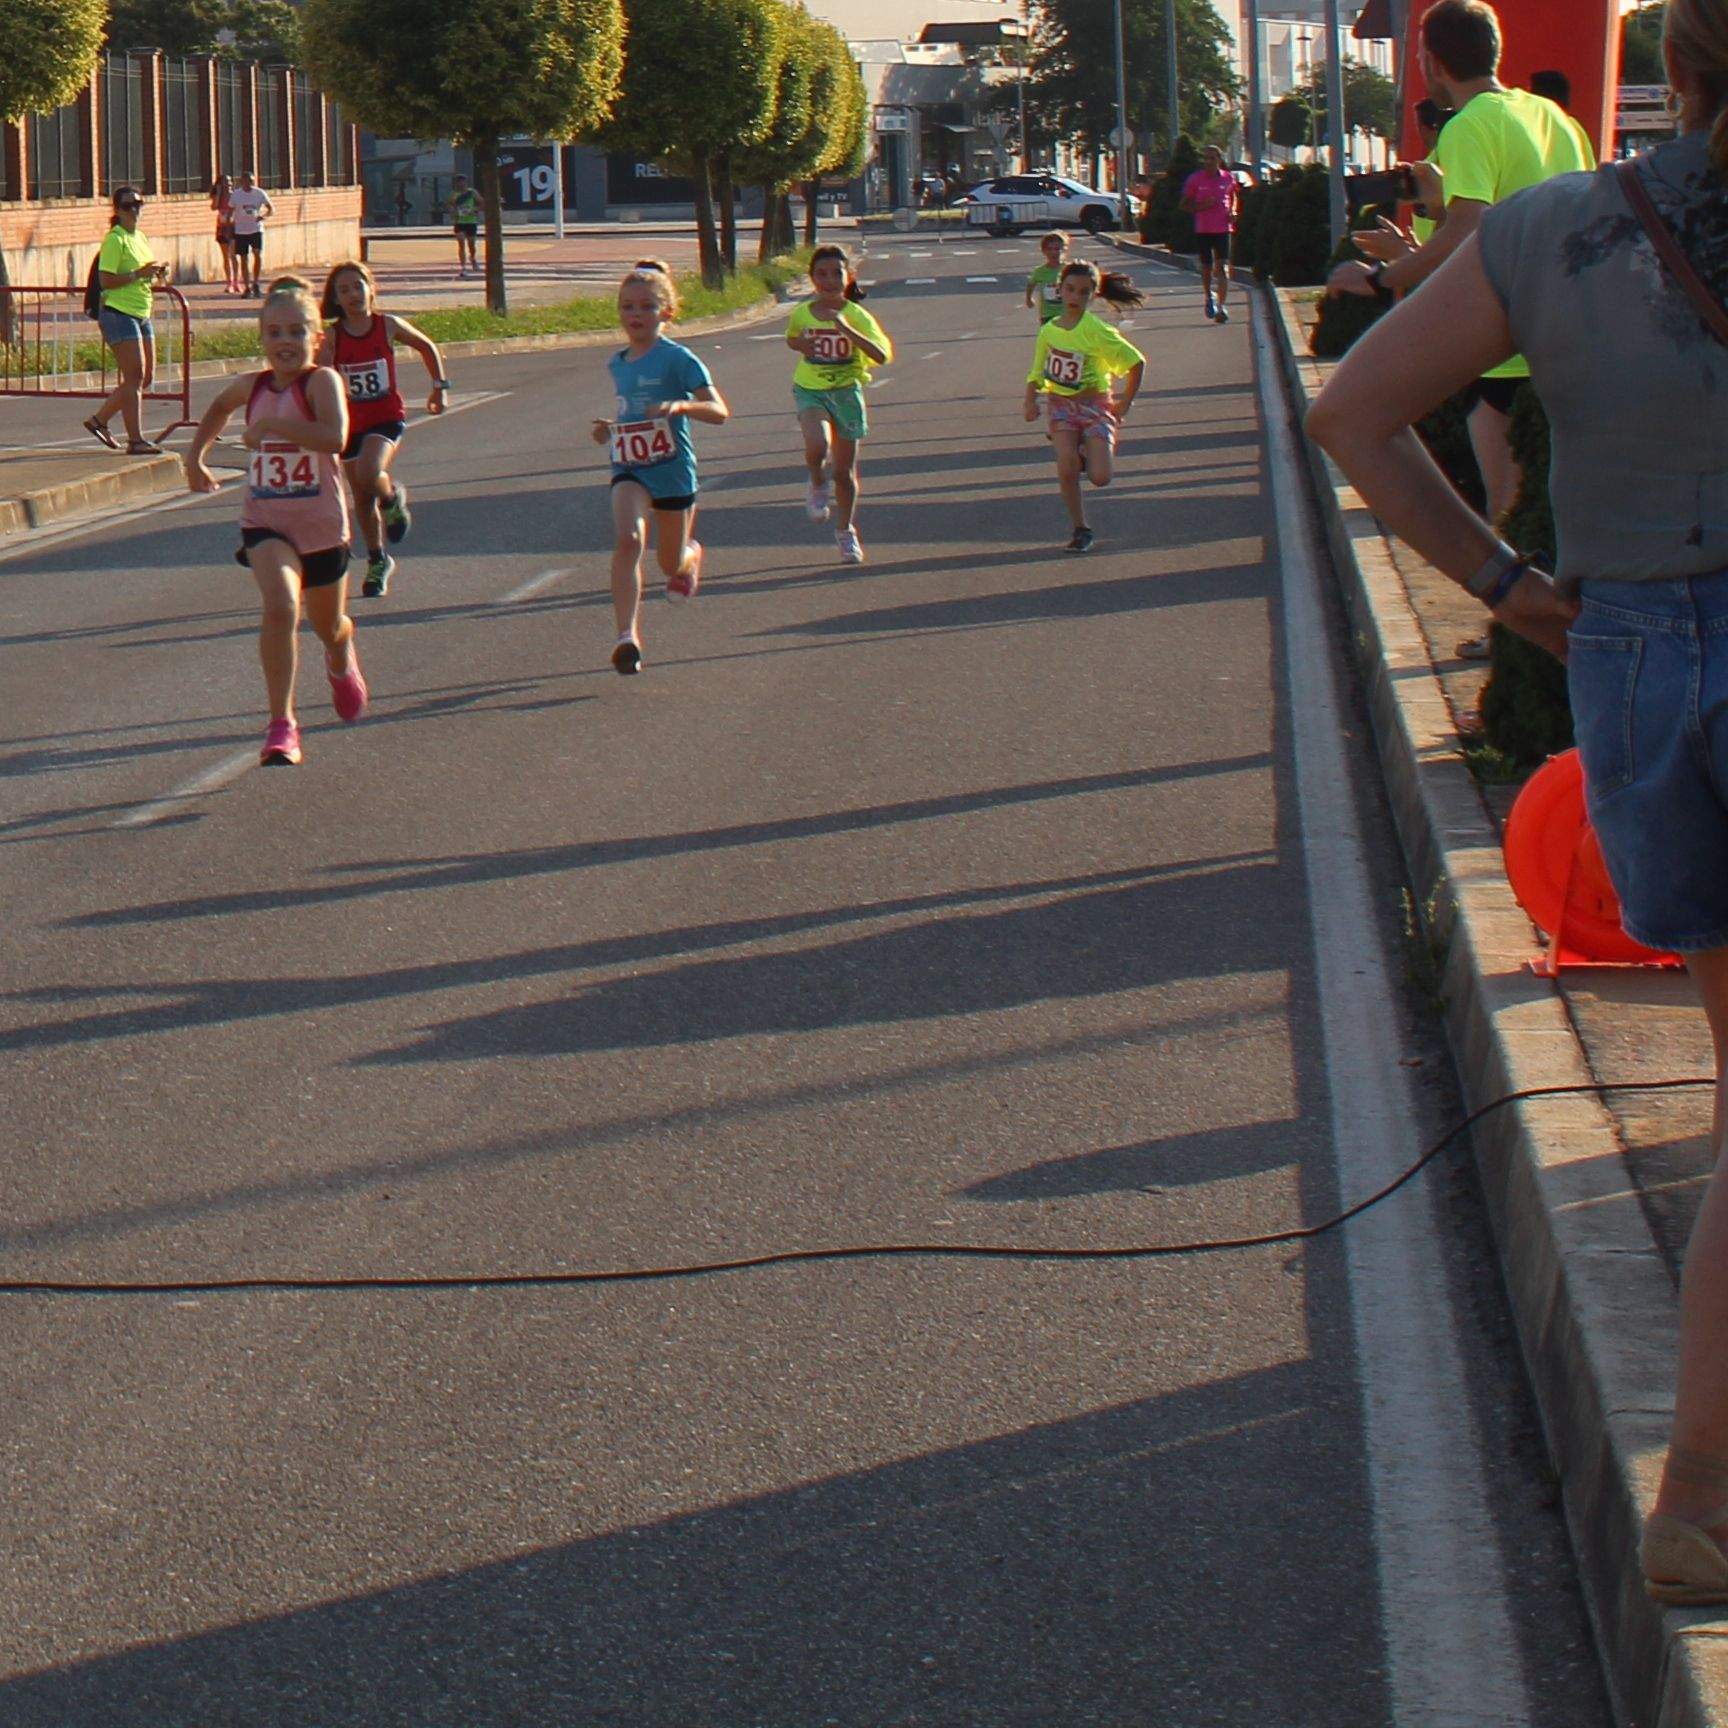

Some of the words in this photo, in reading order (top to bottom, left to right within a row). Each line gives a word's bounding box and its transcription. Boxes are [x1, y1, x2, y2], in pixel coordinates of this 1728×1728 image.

[513, 164, 556, 203] 19
[349, 372, 380, 395] 58
[616, 429, 671, 464] 104
[253, 454, 314, 489] 134
